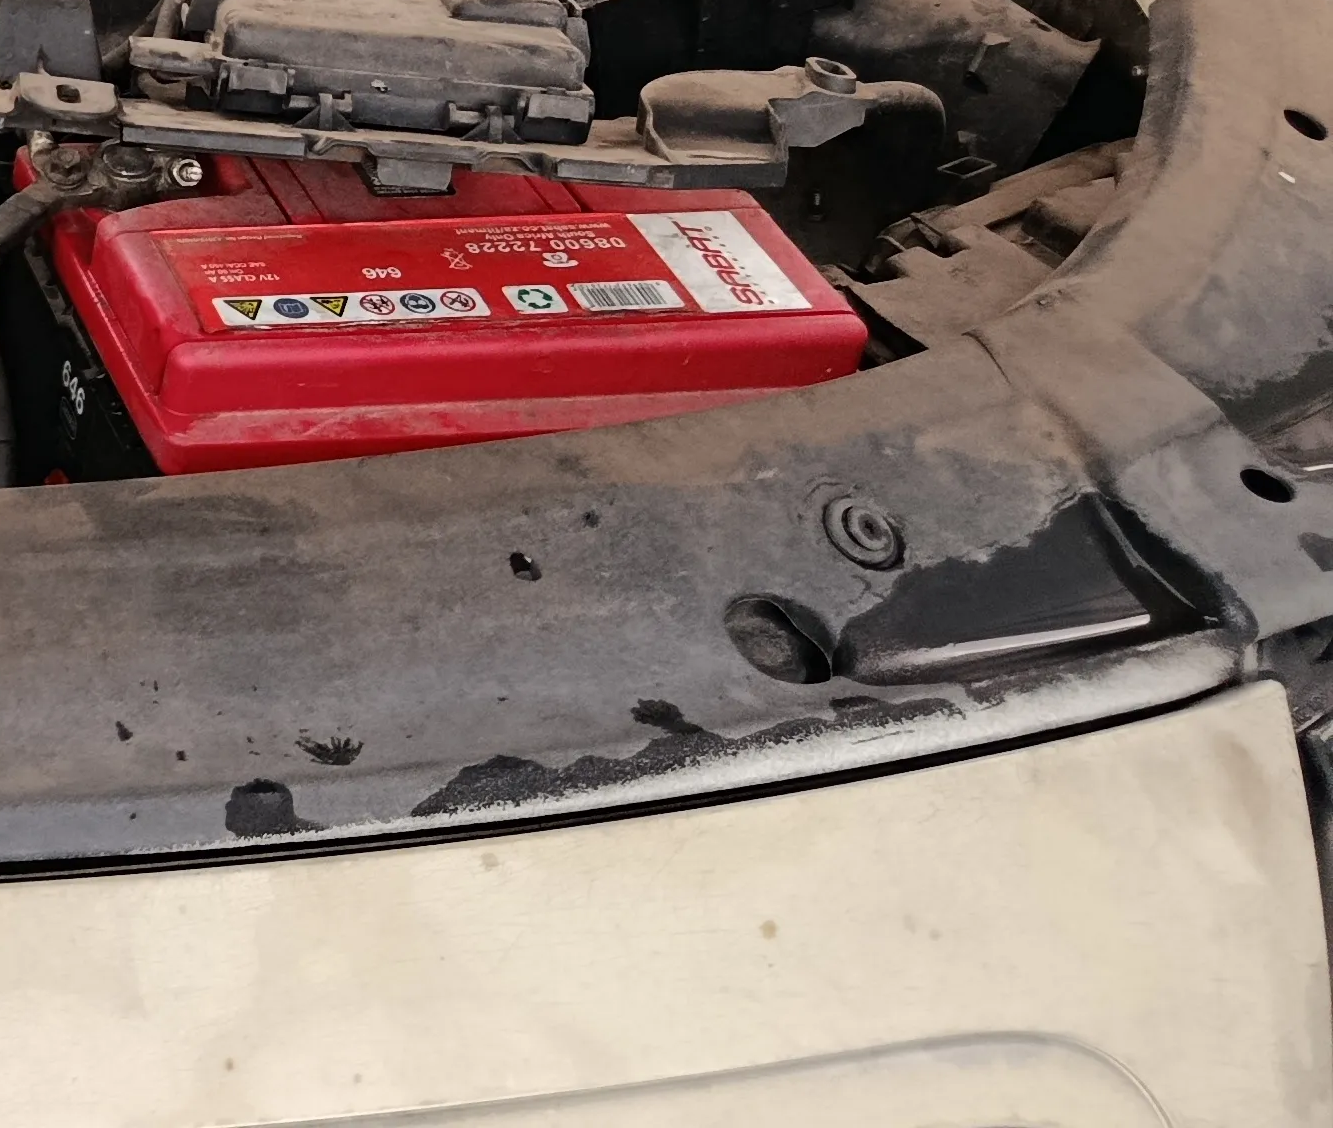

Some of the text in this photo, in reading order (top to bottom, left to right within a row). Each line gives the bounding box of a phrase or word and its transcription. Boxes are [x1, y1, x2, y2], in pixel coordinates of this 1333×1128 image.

[485, 230, 597, 242] South Africa Only
[464, 236, 627, 254] 08600 72228
[671, 220, 764, 306] SABAT
[219, 274, 257, 283] CLASS
[259, 273, 281, 281] 12V
[361, 266, 402, 280] 646
[62, 360, 86, 415] 646
